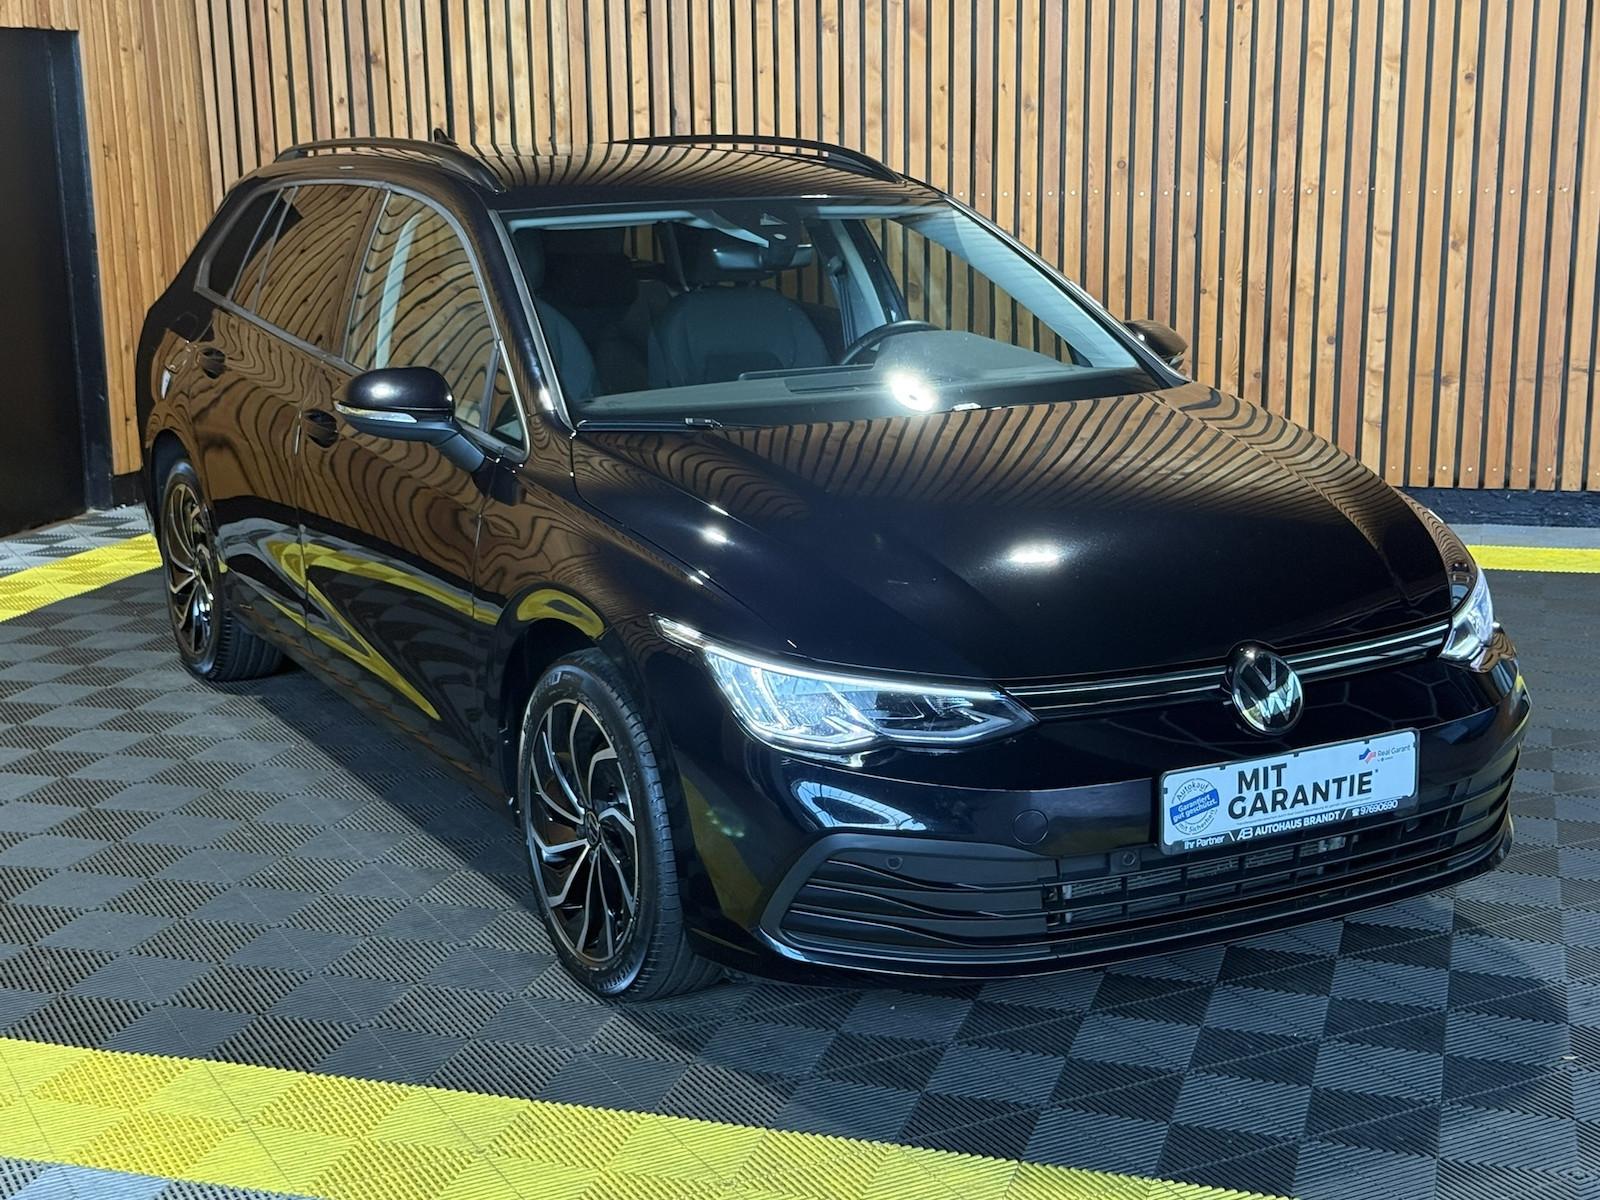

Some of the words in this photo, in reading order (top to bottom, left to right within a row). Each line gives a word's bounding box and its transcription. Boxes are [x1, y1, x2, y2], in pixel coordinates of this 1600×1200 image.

[1377, 749, 1390, 757] Real
[1391, 744, 1411, 754] Garant
[1237, 763, 1287, 794] MIT
[1176, 780, 1209, 801] Autokauf
[1227, 771, 1373, 820] GARANTIE
[1177, 794, 1211, 813] Garantiert
[1172, 811, 1186, 824] gut
[1184, 840, 1195, 849] Ihr
[1196, 835, 1225, 848] Partner
[1254, 818, 1302, 836] AUTOHAUS
[1303, 810, 1341, 827] BRANDT
